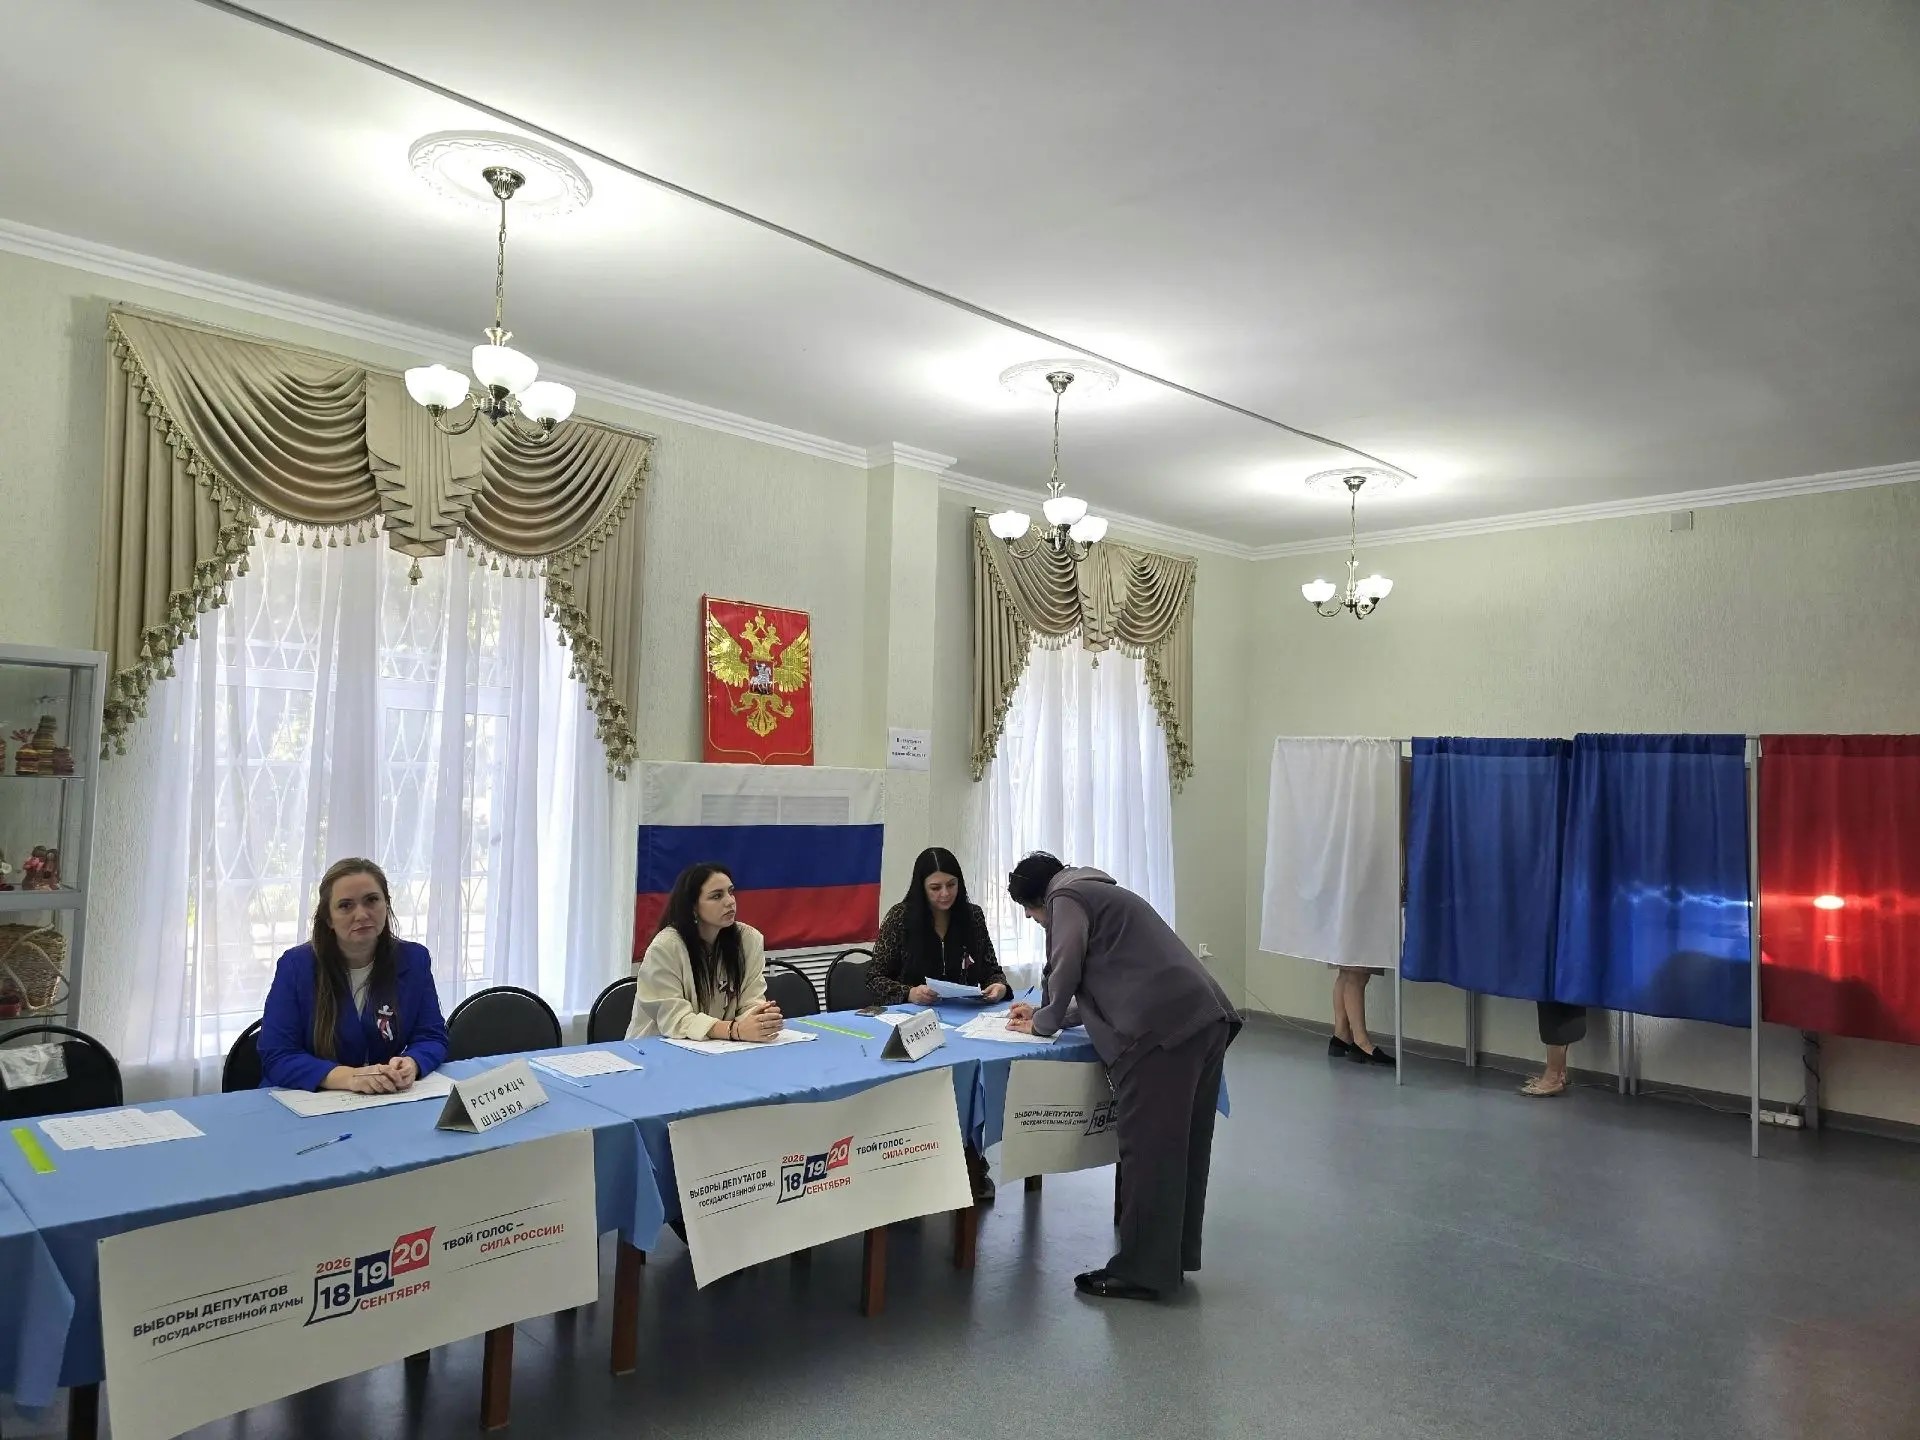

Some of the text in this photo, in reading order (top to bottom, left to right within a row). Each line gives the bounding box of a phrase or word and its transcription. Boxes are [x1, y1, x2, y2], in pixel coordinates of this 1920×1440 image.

[470, 1077, 525, 1108] РСТУФХЦЧ
[480, 1100, 524, 1127] ШЩЭЮЯ
[1042, 1110, 1084, 1118] ДЕПУТАТОВ
[1093, 1114, 1105, 1128] 18
[782, 1154, 804, 1164] 2026
[856, 1142, 878, 1155] ТВОЙ
[878, 1137, 904, 1150] ГОЛОС
[882, 1141, 939, 1160] СИЛА РОССИИ!
[784, 1144, 848, 1192] 18 19 20
[689, 1169, 767, 1199] ВЫБОРЫ ДЕПУТАТОВ
[698, 1180, 775, 1208] ГОСУДАРСТВЕННОЙ ДУМЫ
[806, 1176, 851, 1195] СЕНТЯБРЯ
[442, 1231, 474, 1251] ТВОЙ
[476, 1222, 514, 1241] ГОЛОС
[480, 1223, 565, 1253] СИЛА РОССИИ!
[316, 1257, 351, 1274] 2026
[320, 1238, 428, 1310] 18 19 20
[359, 1280, 431, 1311] СЕНТЯБРЯ
[133, 1285, 288, 1337] ВЫБОРЫ ДЕПУТАТОВ
[152, 1296, 304, 1346] ГОСУДАРСТВЕННОЙ ДУМЫ
